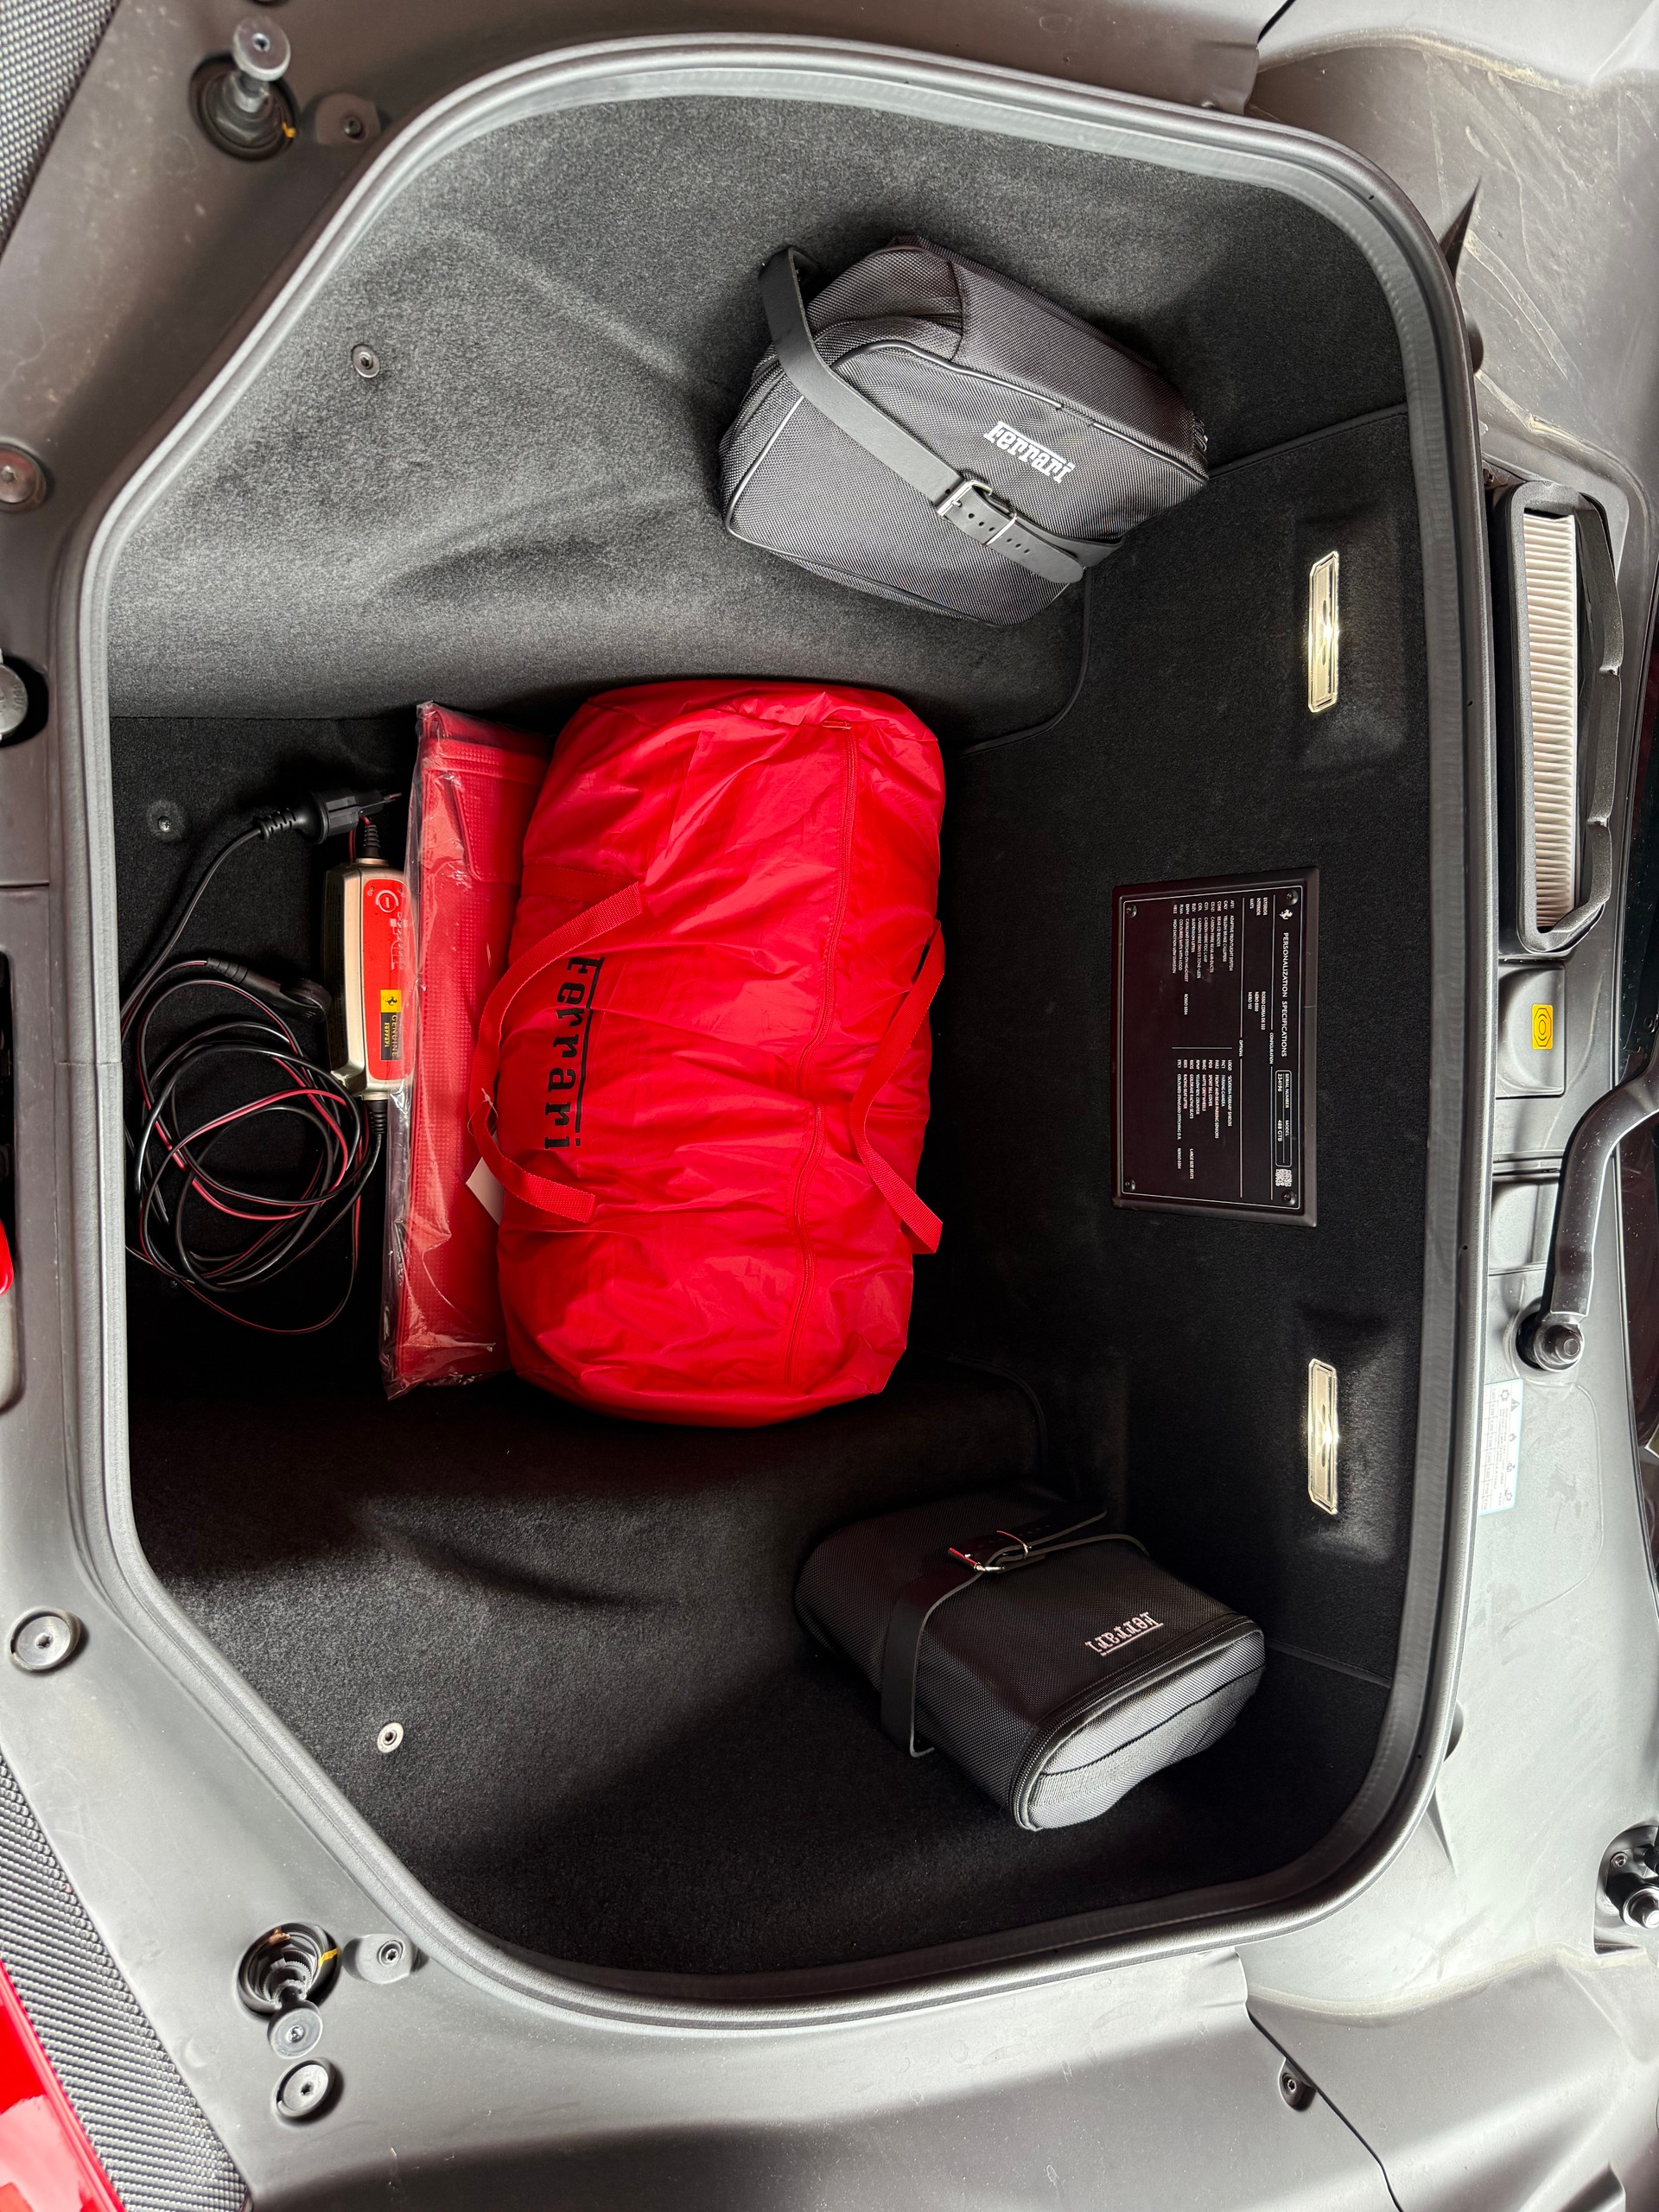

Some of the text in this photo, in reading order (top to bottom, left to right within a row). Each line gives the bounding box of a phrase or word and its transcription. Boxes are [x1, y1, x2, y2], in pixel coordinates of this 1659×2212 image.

[983, 421, 1076, 484] Ferrari
[544, 957, 605, 1149] Ferrari
[1084, 1611, 1164, 1656] Ferrari
